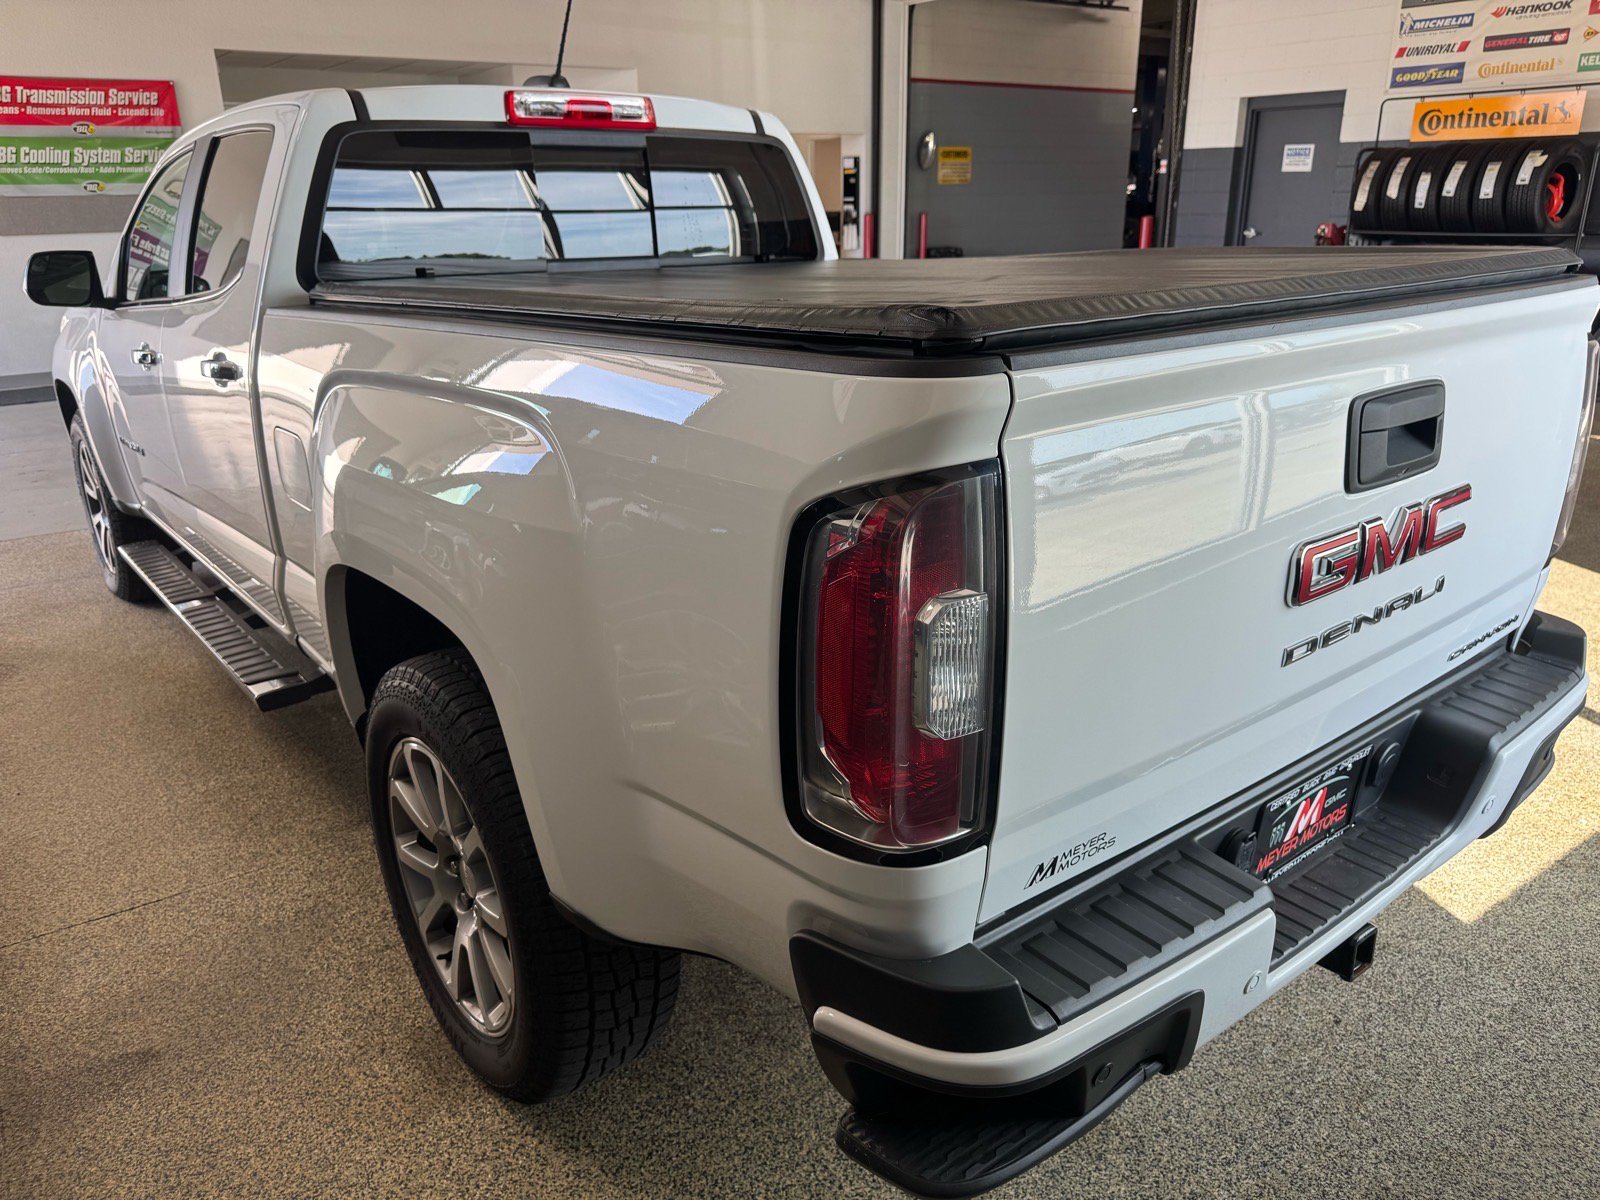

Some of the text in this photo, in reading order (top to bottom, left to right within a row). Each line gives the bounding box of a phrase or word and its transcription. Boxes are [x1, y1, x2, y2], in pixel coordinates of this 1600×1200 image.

[1413, 16, 1472, 30] MICHELIN
[1406, 43, 1457, 57] UNIROYAL
[1485, 36, 1527, 48] GENERAL
[1528, 34, 1552, 44] TIRE
[1395, 68, 1459, 82] GOODYEAR
[1477, 58, 1555, 79] Continental
[0, 86, 159, 106] G Transmission Service
[26, 106, 66, 115] Removes
[67, 106, 90, 116] Worn
[91, 107, 112, 116] Fluid
[118, 107, 149, 116] Extends
[150, 107, 165, 117] Life
[1418, 103, 1550, 136] Continental
[20, 146, 70, 166] Cooling
[74, 146, 121, 166] System
[1285, 483, 1472, 607] GMC
[1281, 575, 1445, 668] DENALI
[1324, 788, 1348, 808] GMC
[1060, 832, 1107, 862] MEYER
[1255, 837, 1299, 874] MEYER
[1300, 803, 1348, 846] MOTORS
[1057, 836, 1117, 873] MOTORS
